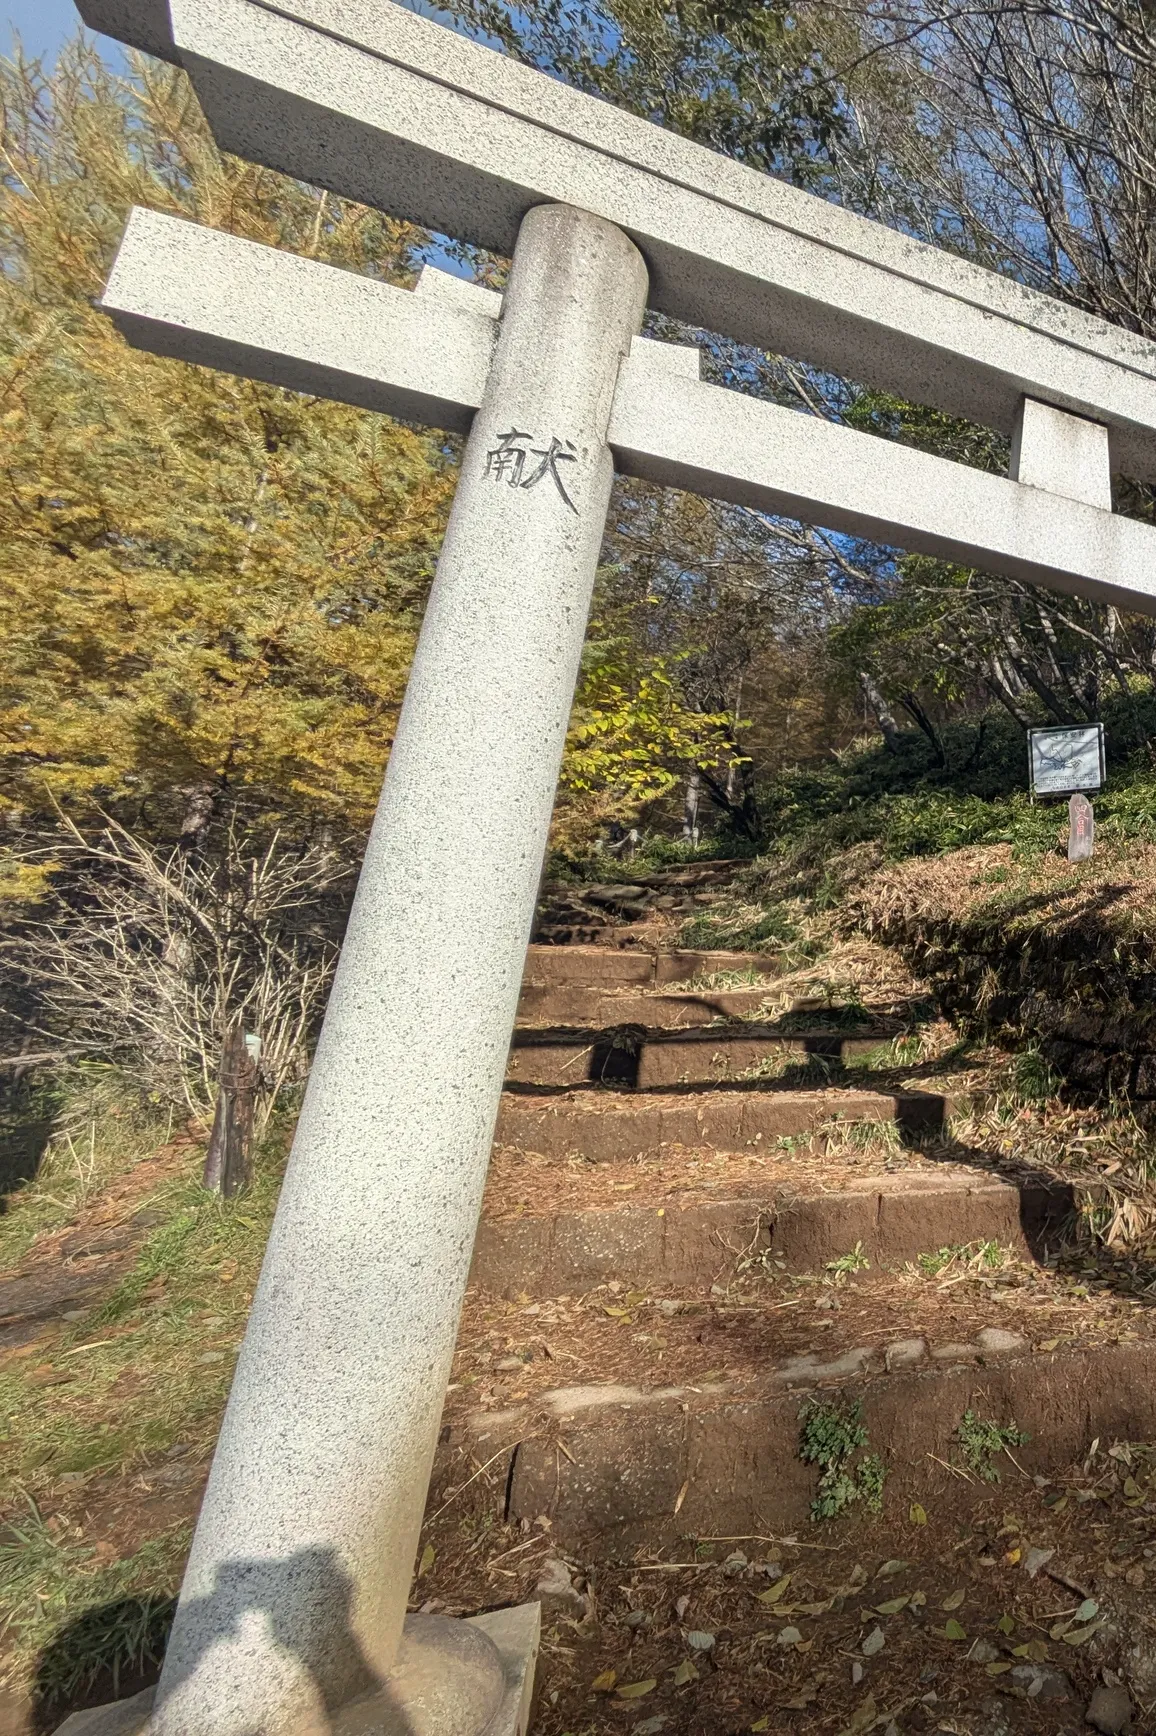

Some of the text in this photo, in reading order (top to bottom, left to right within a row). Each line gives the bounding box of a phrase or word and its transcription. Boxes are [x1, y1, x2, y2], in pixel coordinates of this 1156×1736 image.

[482, 426, 580, 516] 献
[1074, 804, 1089, 836] 四合目
